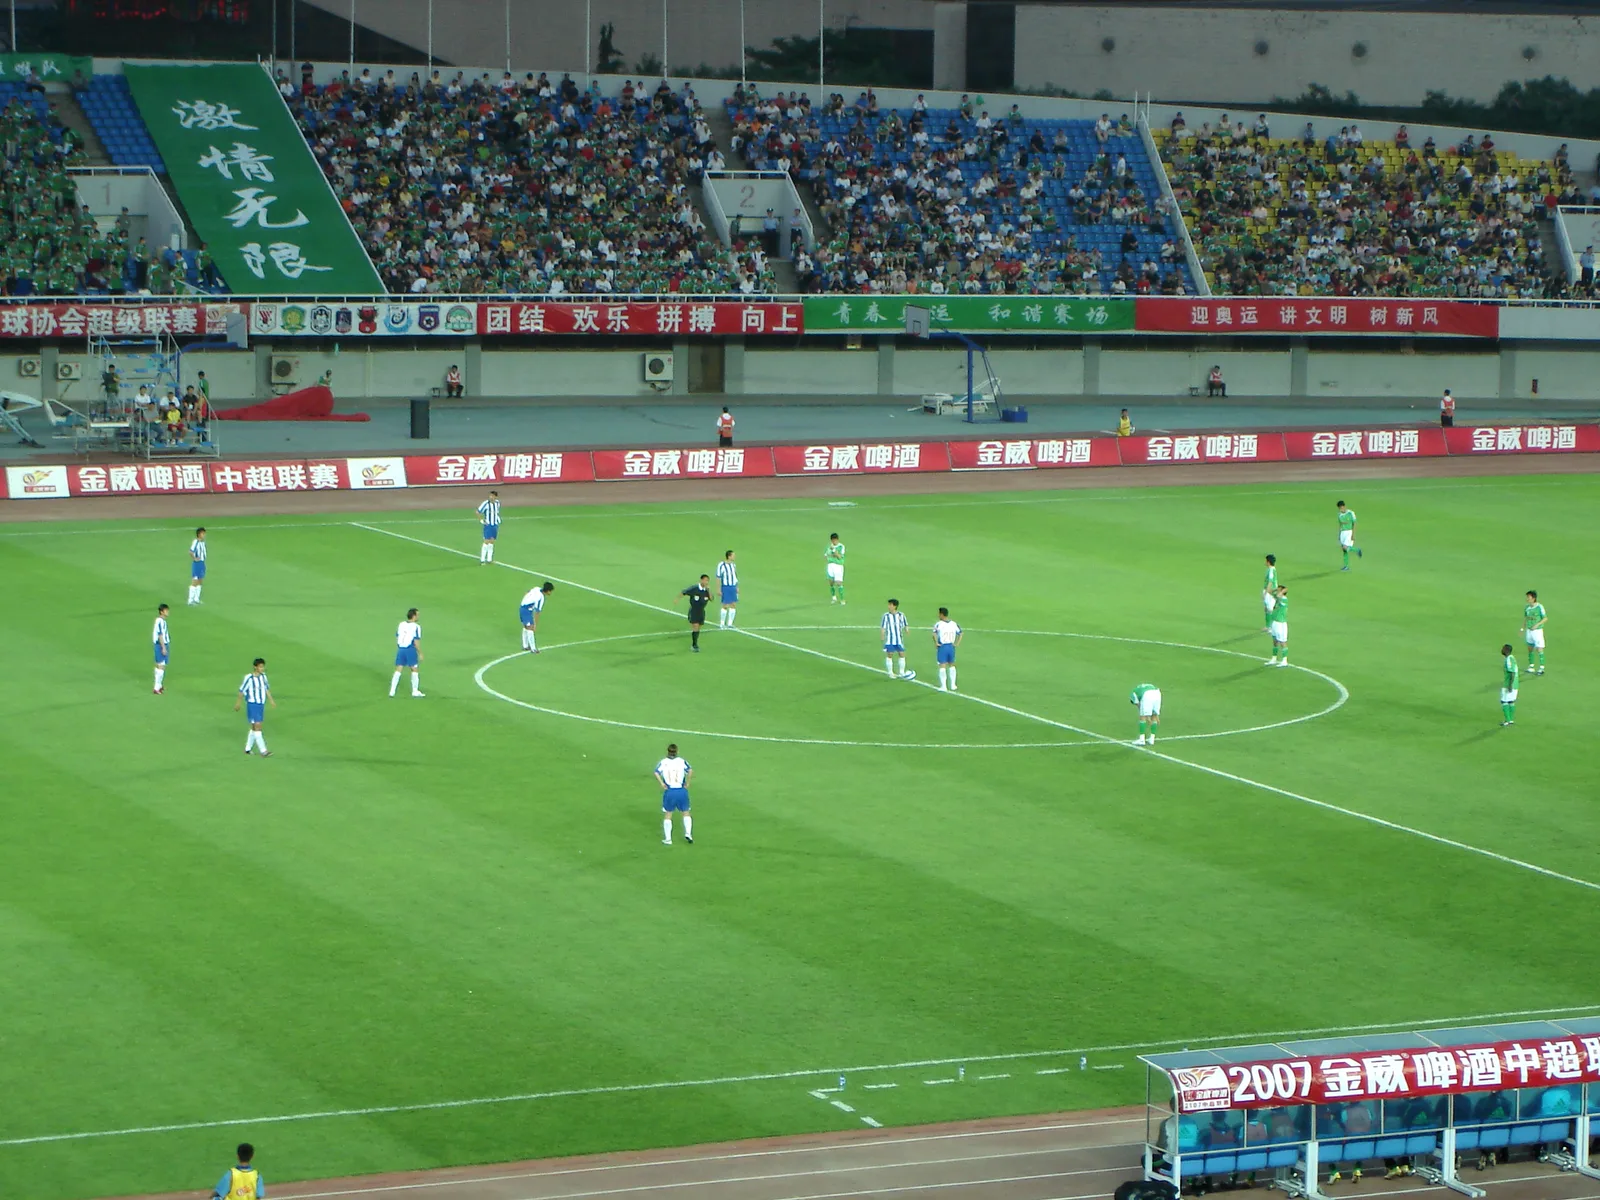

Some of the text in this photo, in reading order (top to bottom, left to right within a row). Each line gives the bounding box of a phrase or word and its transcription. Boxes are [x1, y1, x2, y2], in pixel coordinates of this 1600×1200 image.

[172, 100, 333, 279] 激情无限
[740, 185, 755, 208] 2
[2, 307, 197, 336] 球协会超级联赛
[486, 304, 798, 333] 团结 欢乐 拼搏 向上
[832, 303, 1108, 325] 青春运 和谐赛场
[1191, 306, 1439, 326] 迎奥运 讲文明 树新风
[1146, 434, 1258, 461] 金威啤酒
[1311, 430, 1419, 457] 金威啤酒
[1471, 426, 1577, 451] 金威啤酒
[623, 449, 745, 476] 金威啤酒
[803, 444, 921, 471] 金威啤酒
[977, 439, 1091, 466] 金威啤酒
[78, 464, 339, 492] 金威啤酒 中超联赛
[436, 453, 563, 481] 金威啤酒
